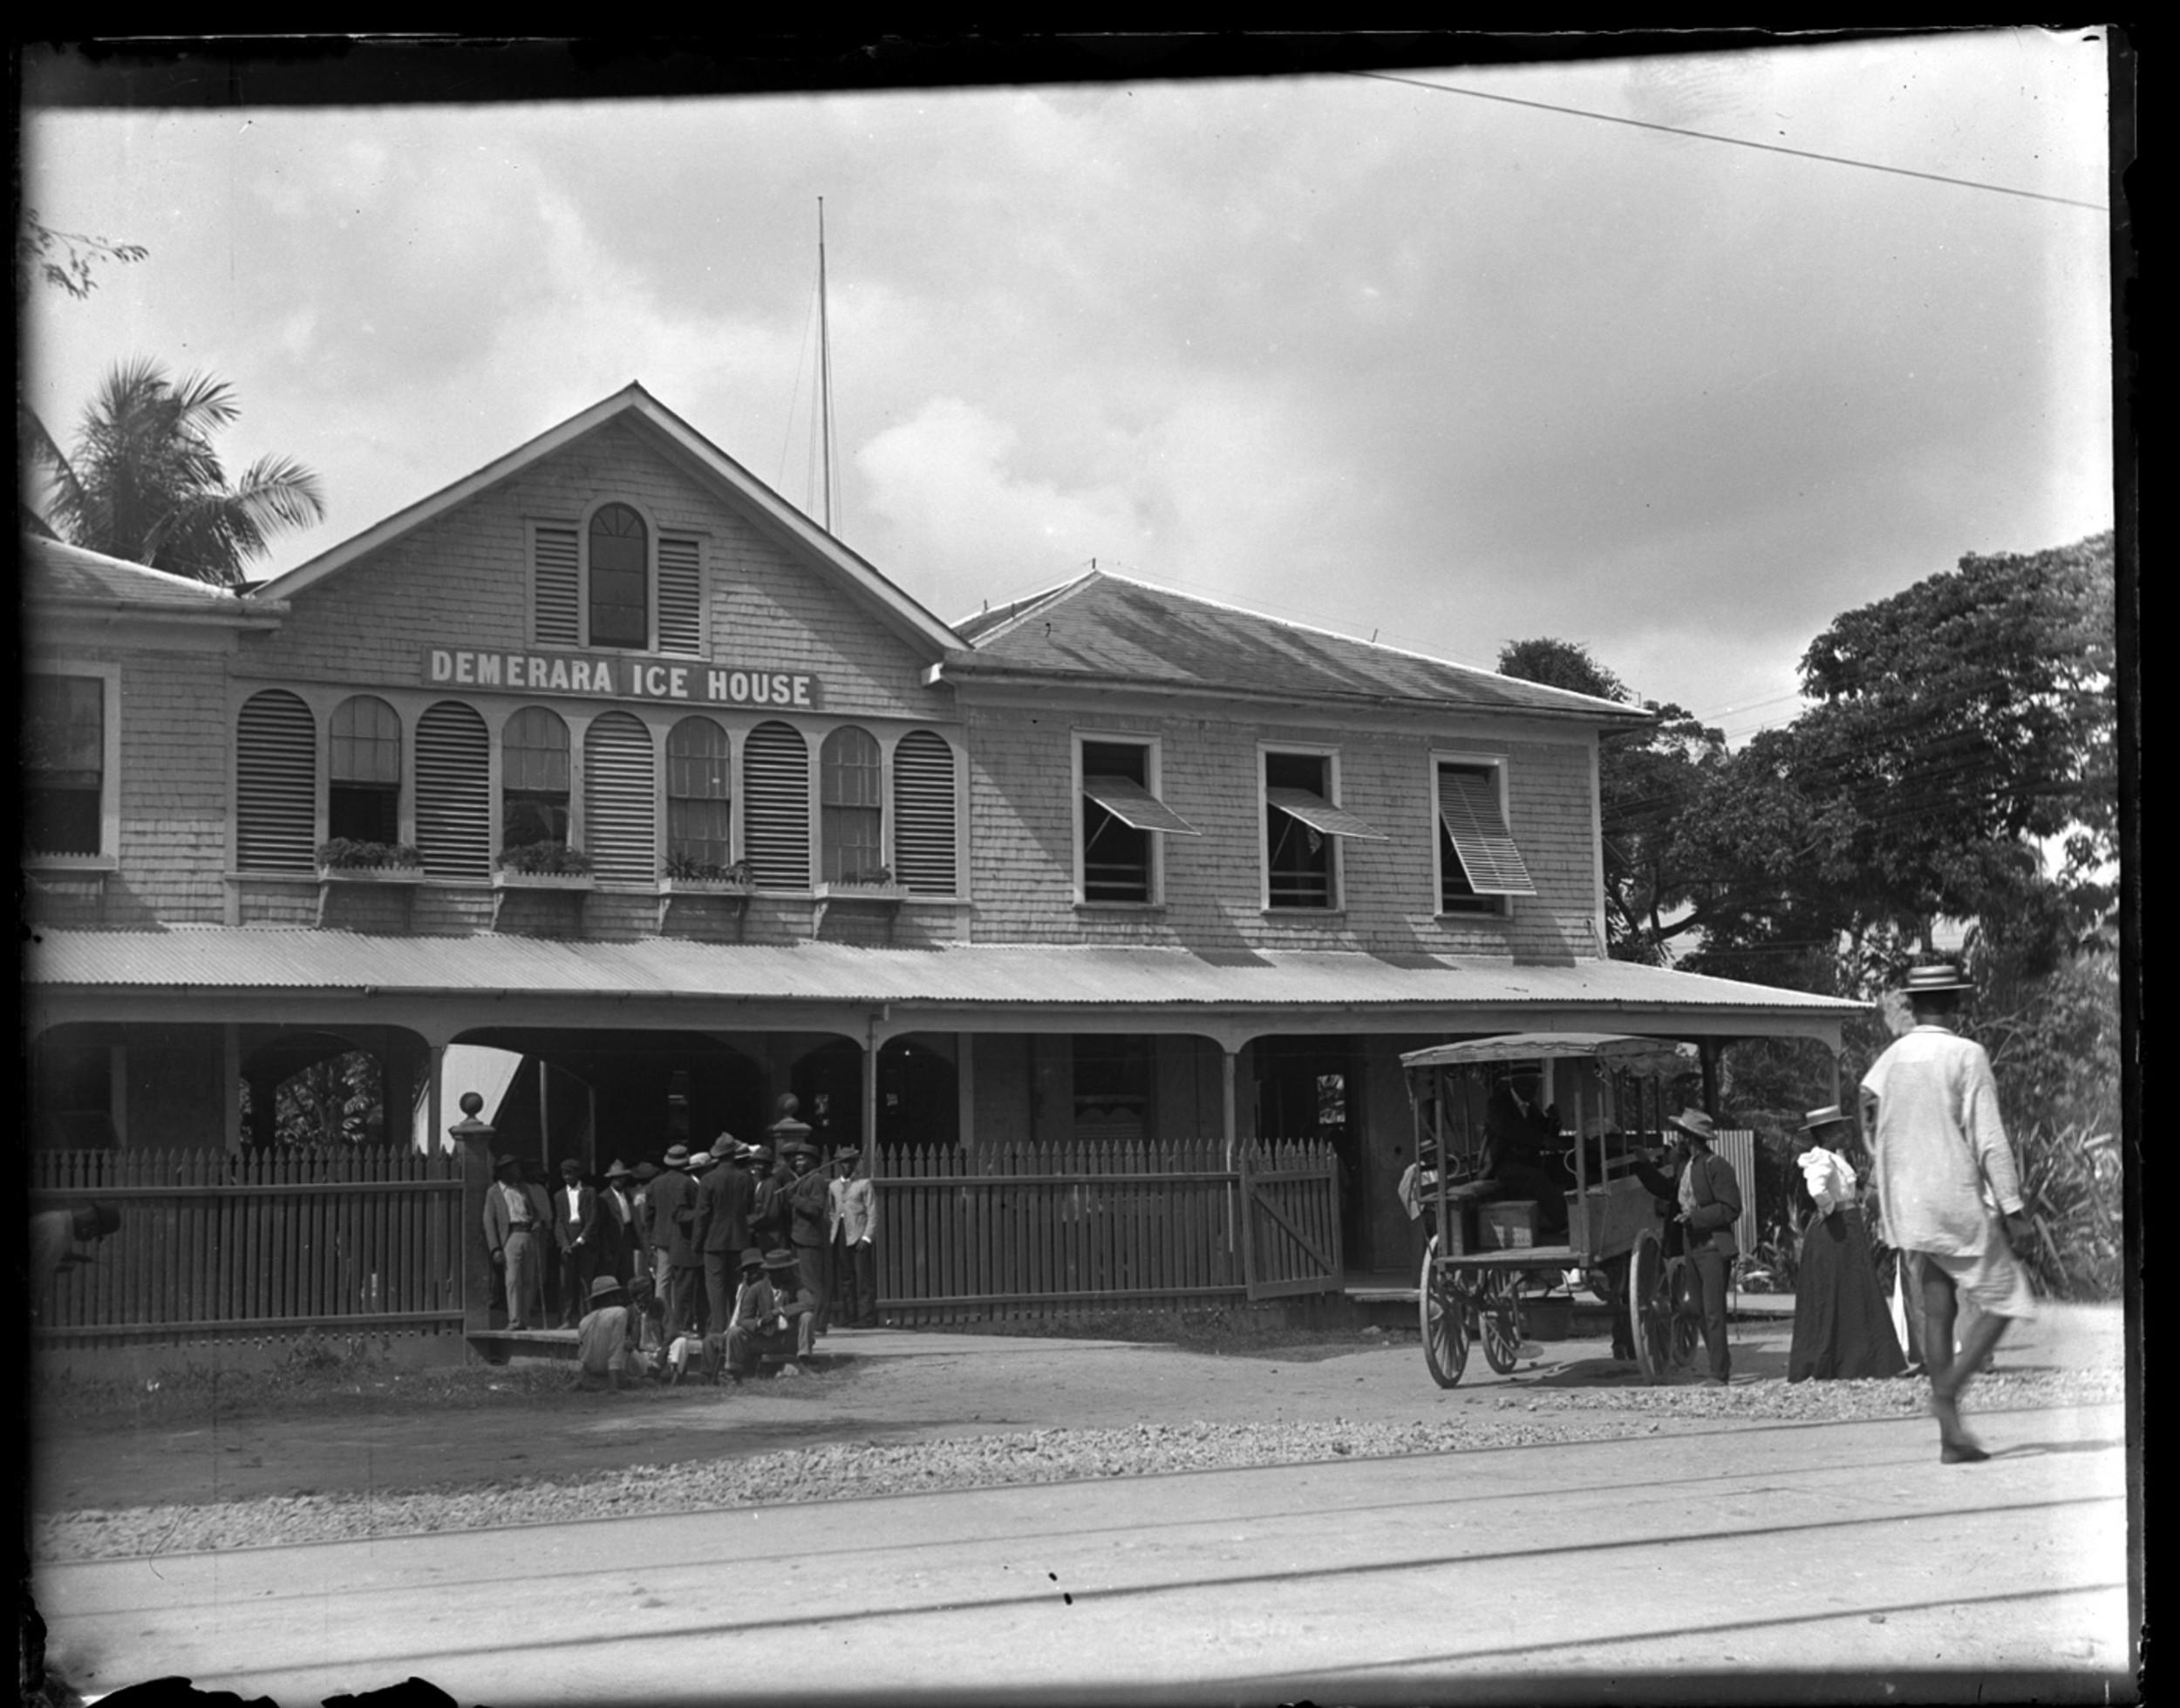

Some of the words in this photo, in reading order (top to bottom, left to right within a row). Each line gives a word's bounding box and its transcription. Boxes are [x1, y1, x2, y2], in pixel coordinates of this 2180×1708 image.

[431, 650, 612, 691] DEMERARA
[632, 664, 689, 698] ICE
[707, 670, 811, 704] HOUSE
